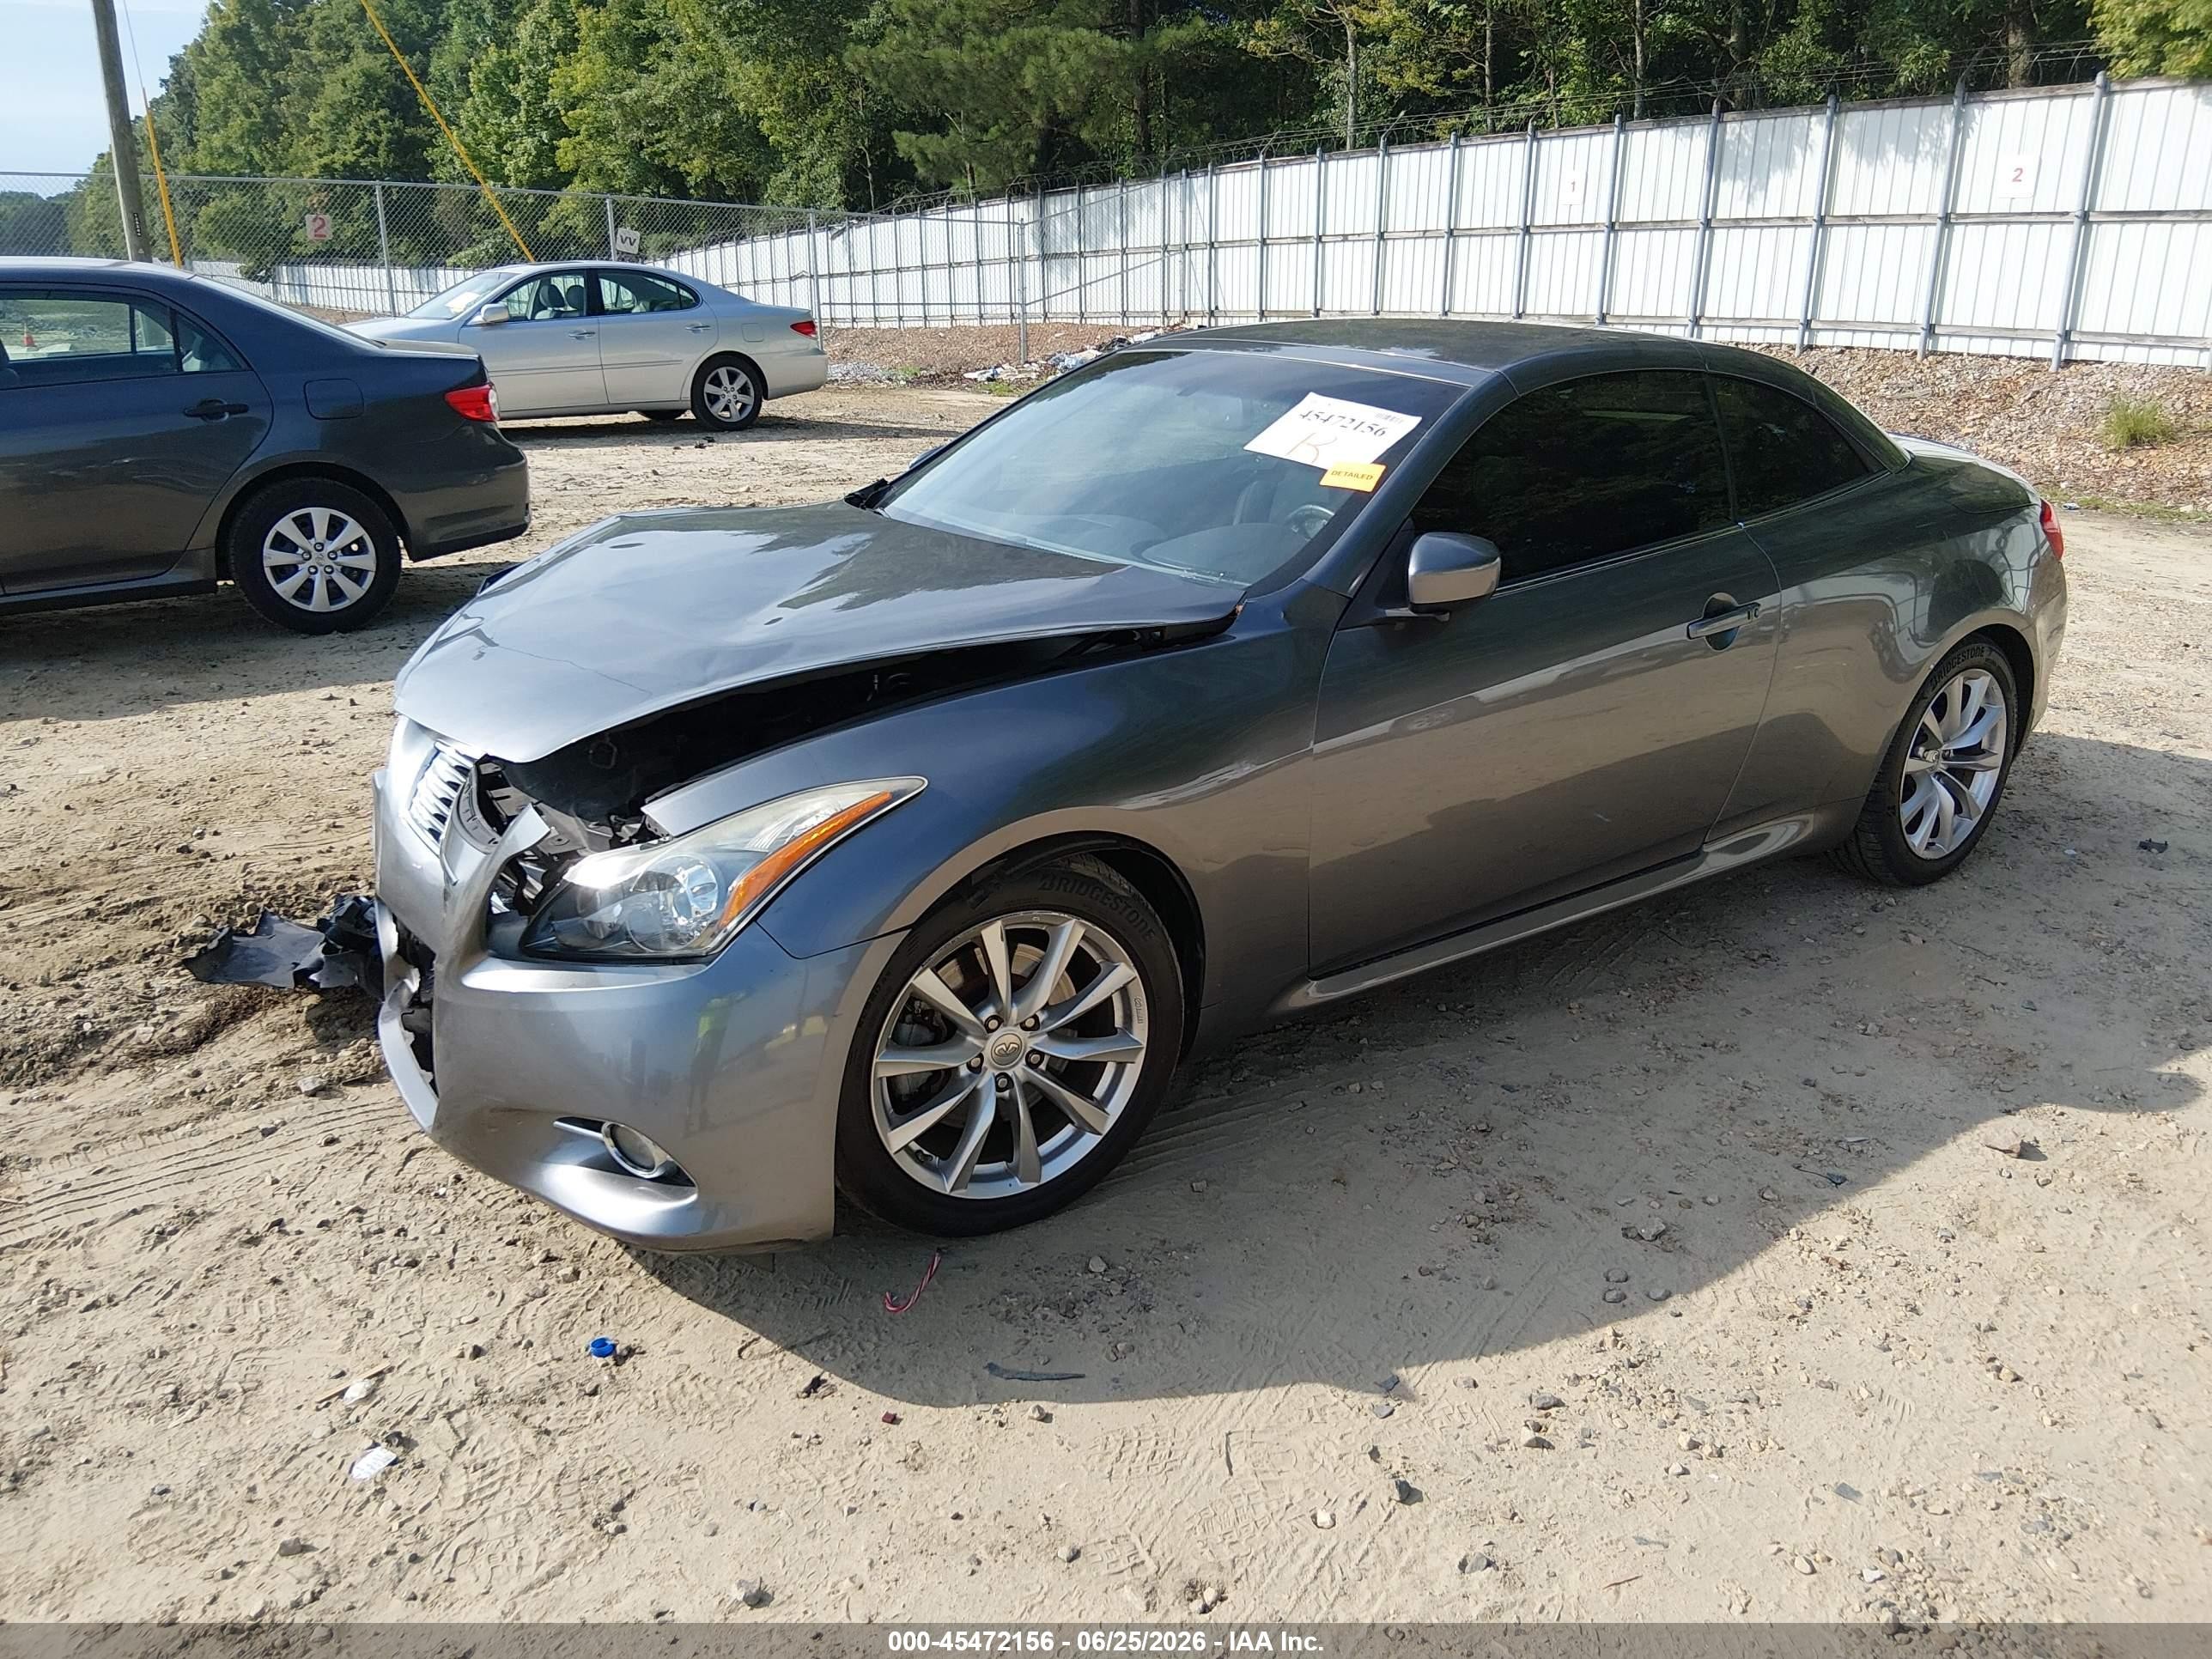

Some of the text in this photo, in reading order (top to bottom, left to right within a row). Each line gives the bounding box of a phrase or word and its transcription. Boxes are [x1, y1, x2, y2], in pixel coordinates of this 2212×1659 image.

[2012, 167, 2023, 182] 2
[312, 216, 326, 238] 2
[1299, 410, 1388, 437] 45472156
[1330, 470, 1374, 481] DETAILED
[1037, 874, 1156, 941] BRIDGESTONE
